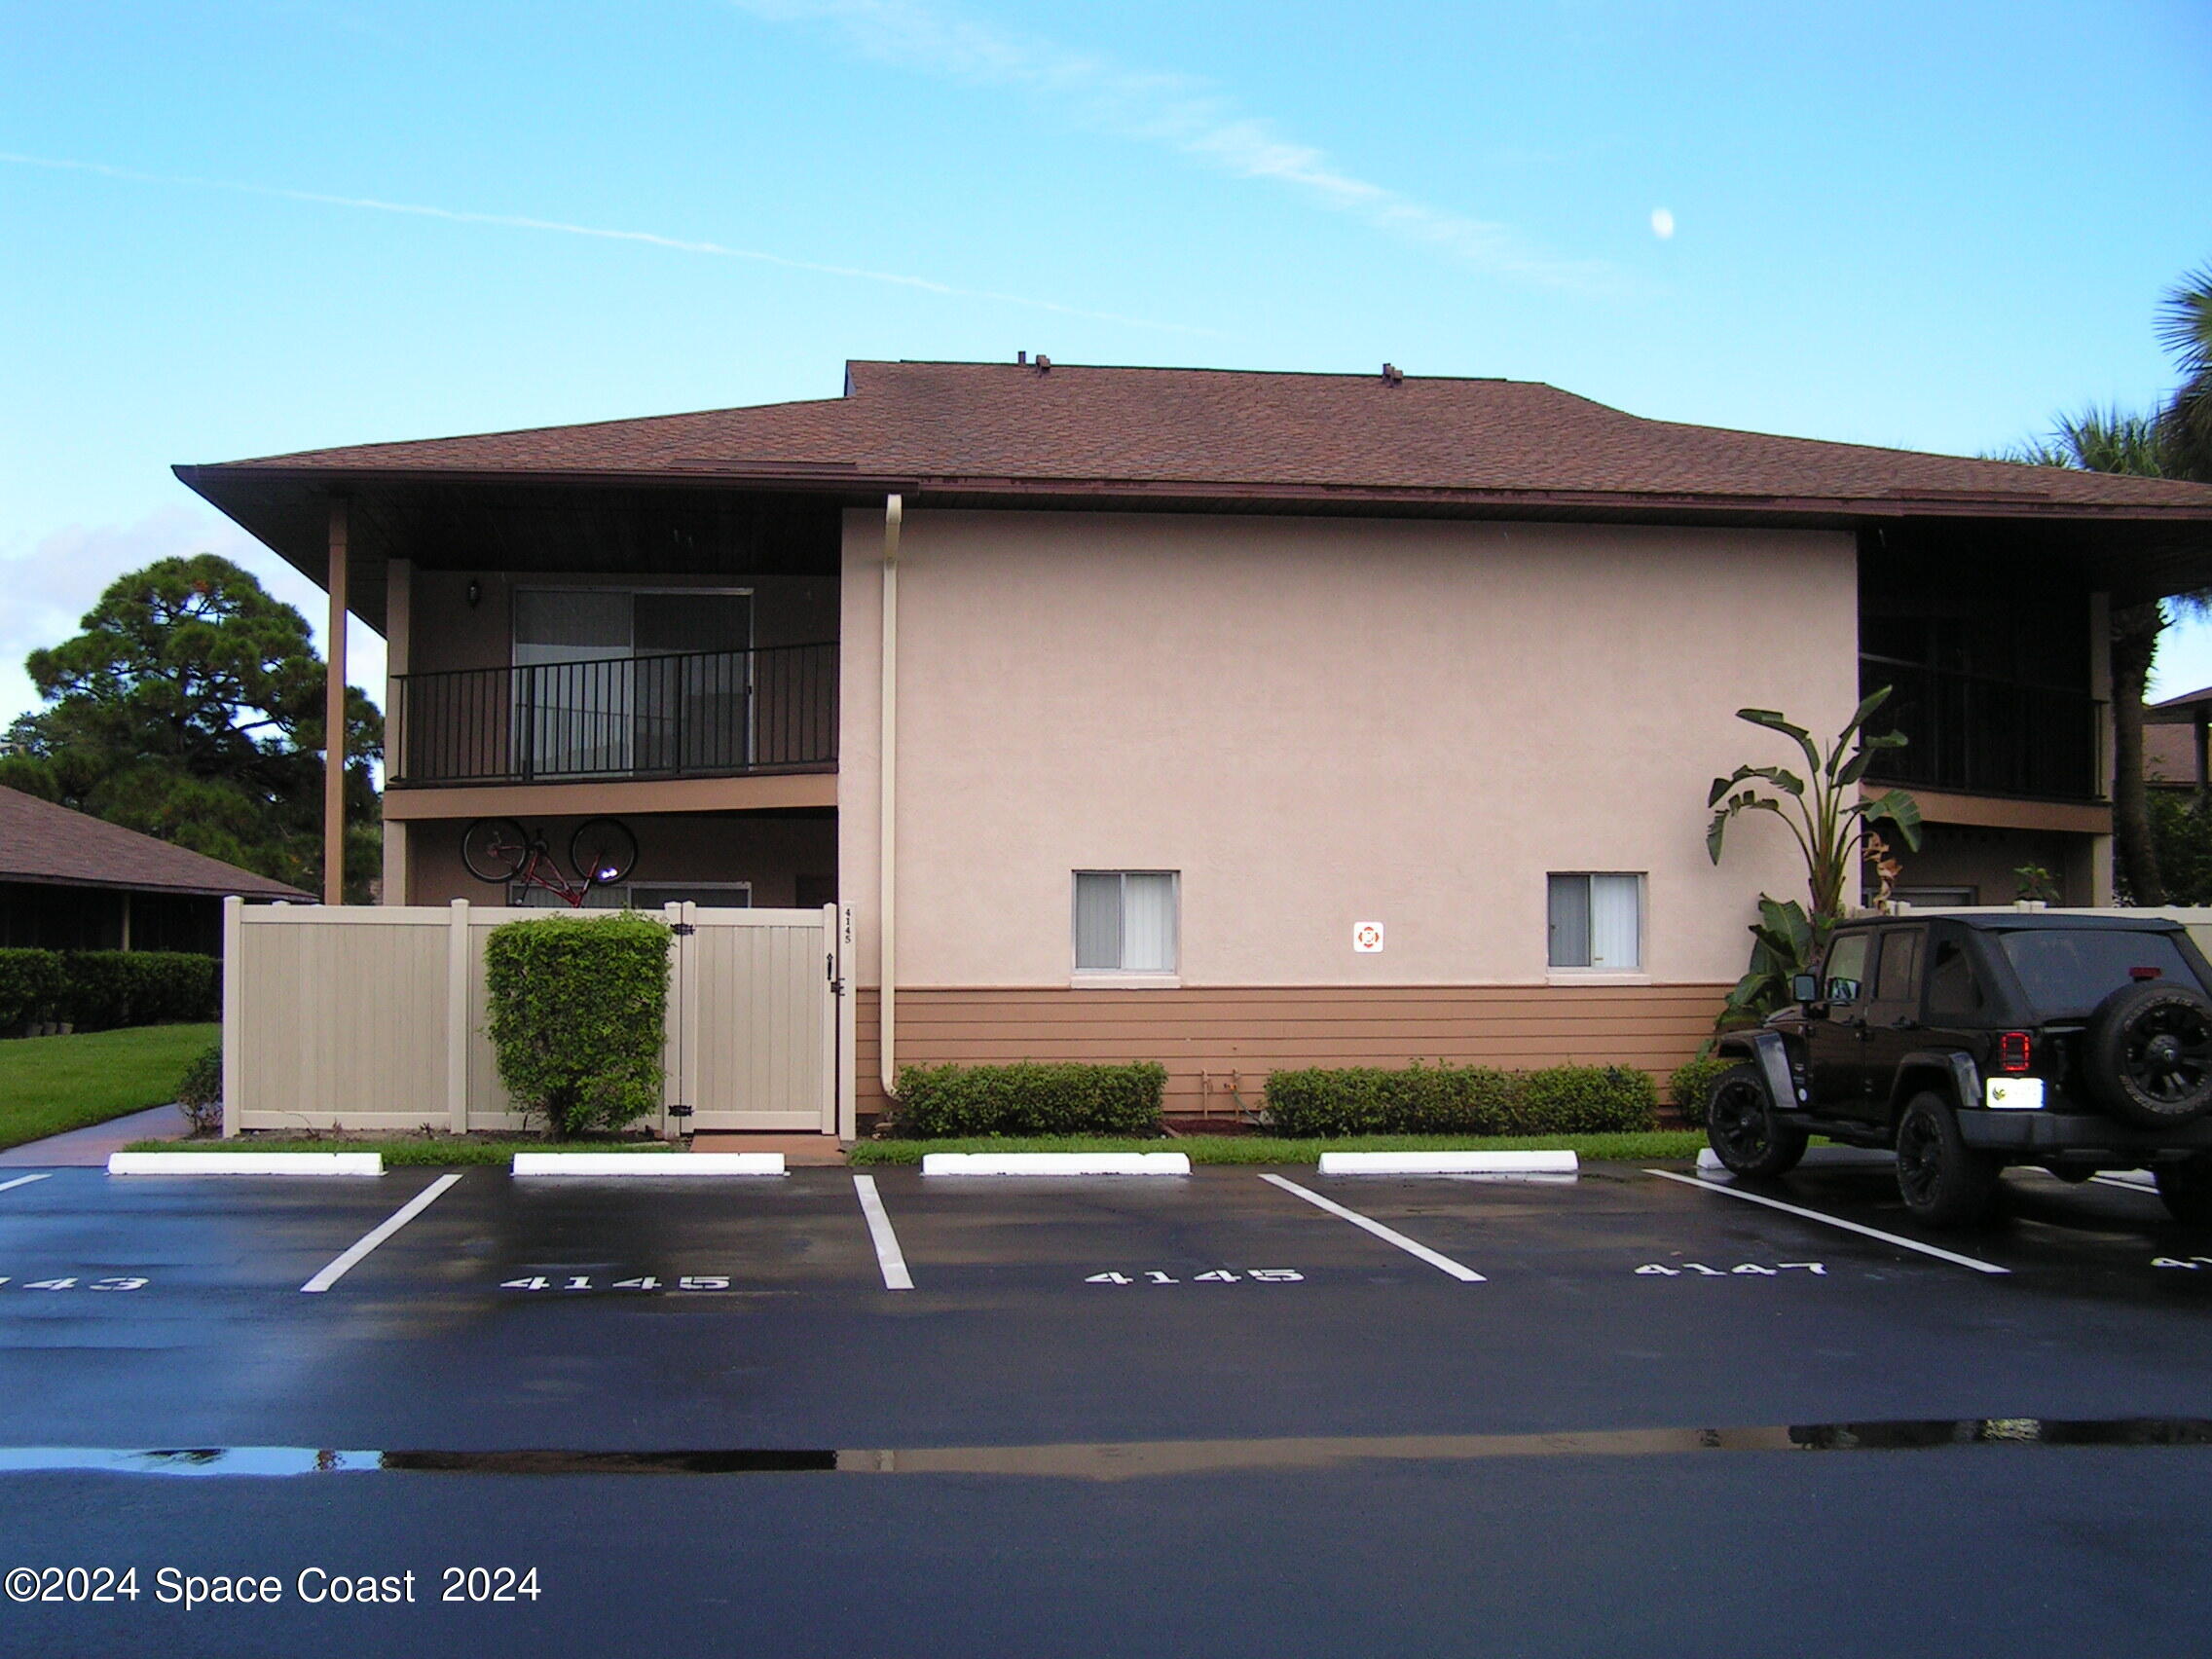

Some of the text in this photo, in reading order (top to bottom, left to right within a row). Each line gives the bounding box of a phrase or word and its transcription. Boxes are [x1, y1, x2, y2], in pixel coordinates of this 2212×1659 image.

[1084, 1269, 1306, 1284] 4145
[1634, 1262, 1828, 1276] 4147
[499, 1275, 730, 1291] 4145
